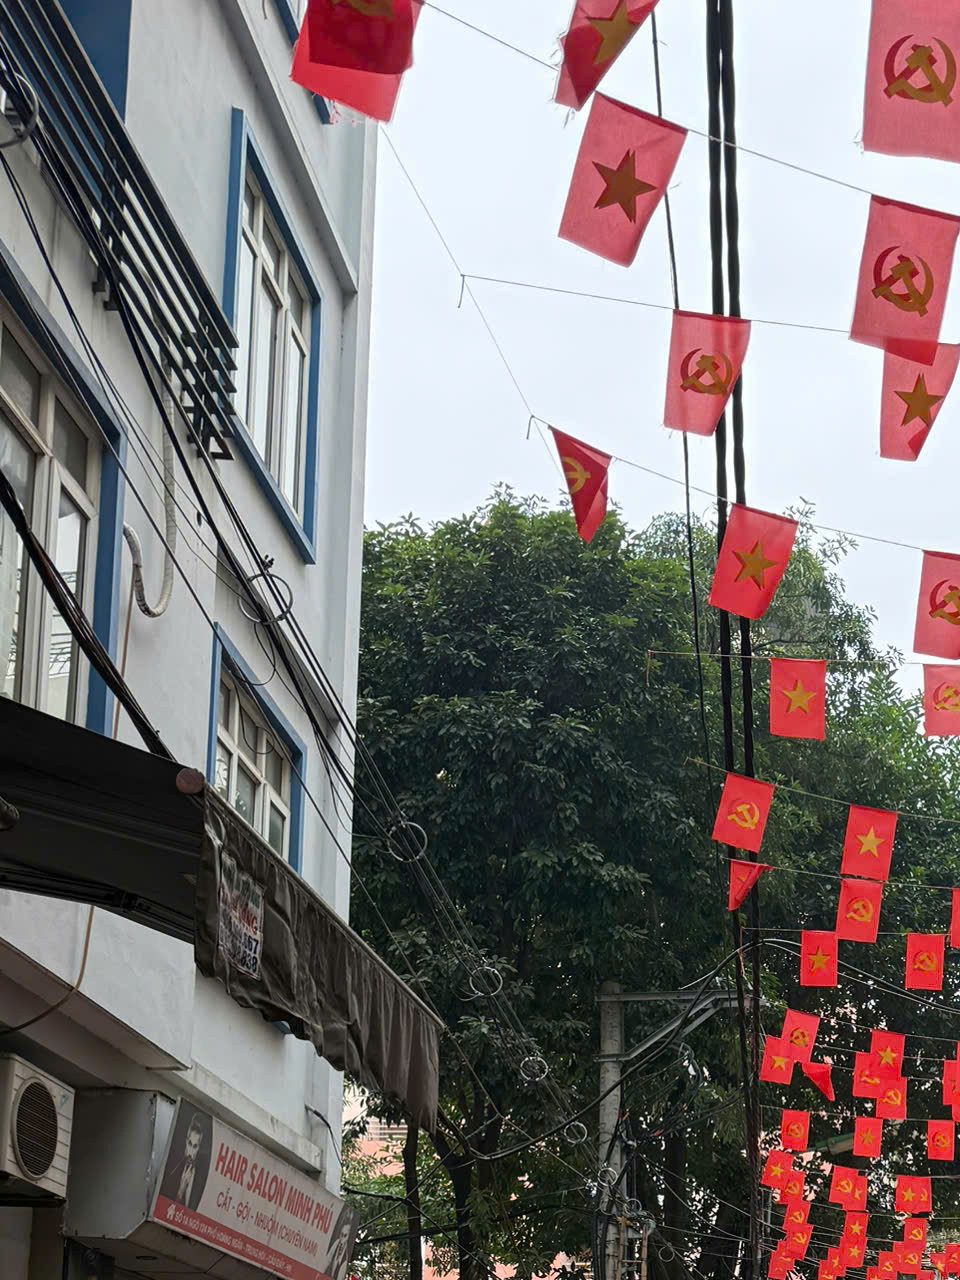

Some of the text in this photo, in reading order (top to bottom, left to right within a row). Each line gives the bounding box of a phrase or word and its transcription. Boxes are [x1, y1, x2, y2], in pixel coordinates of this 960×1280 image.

[215, 1143, 334, 1235] HAIR SALON MINH PHÚ
